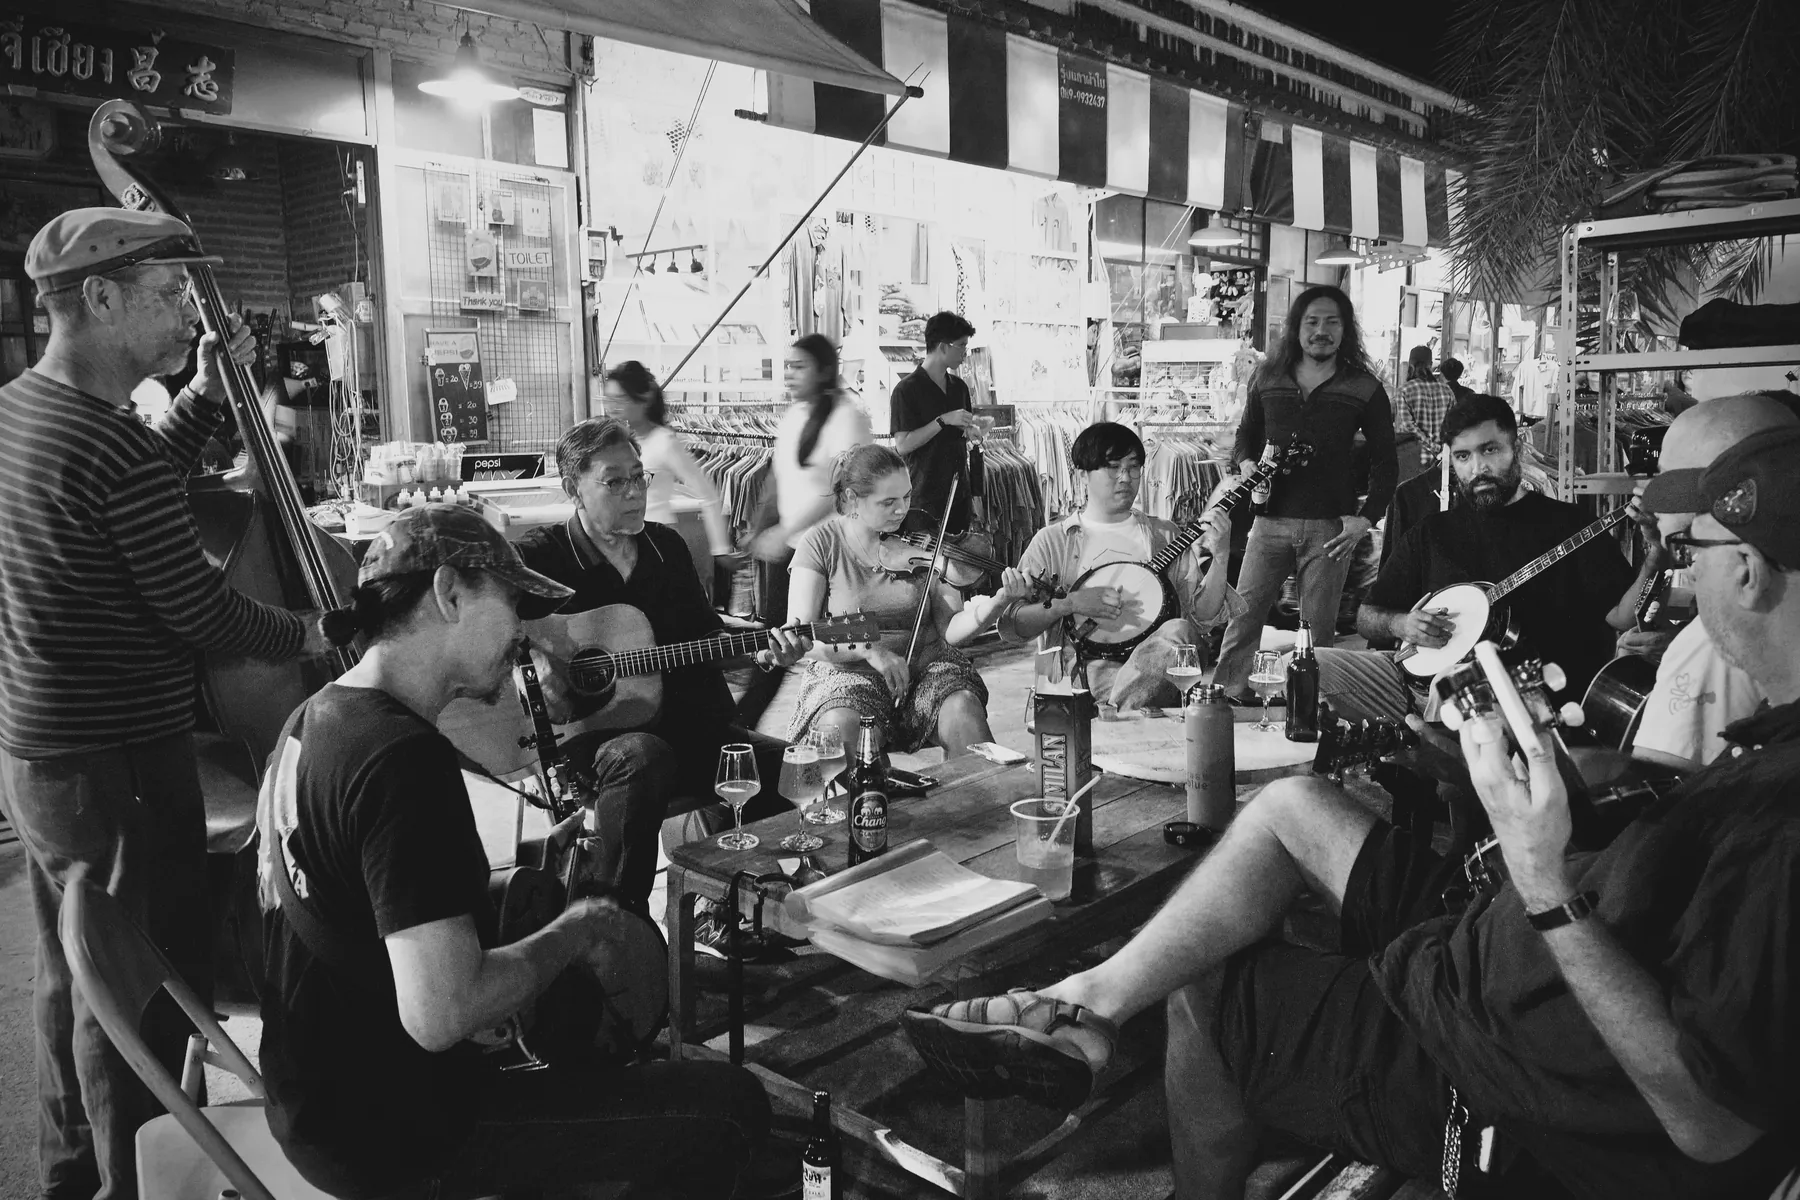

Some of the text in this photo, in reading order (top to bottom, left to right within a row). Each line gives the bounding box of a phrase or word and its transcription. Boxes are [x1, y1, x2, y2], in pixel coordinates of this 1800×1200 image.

[508, 252, 549, 265] TOILET
[463, 296, 503, 308] Thank you
[474, 457, 501, 470] pepsi
[854, 814, 887, 827] Chang
